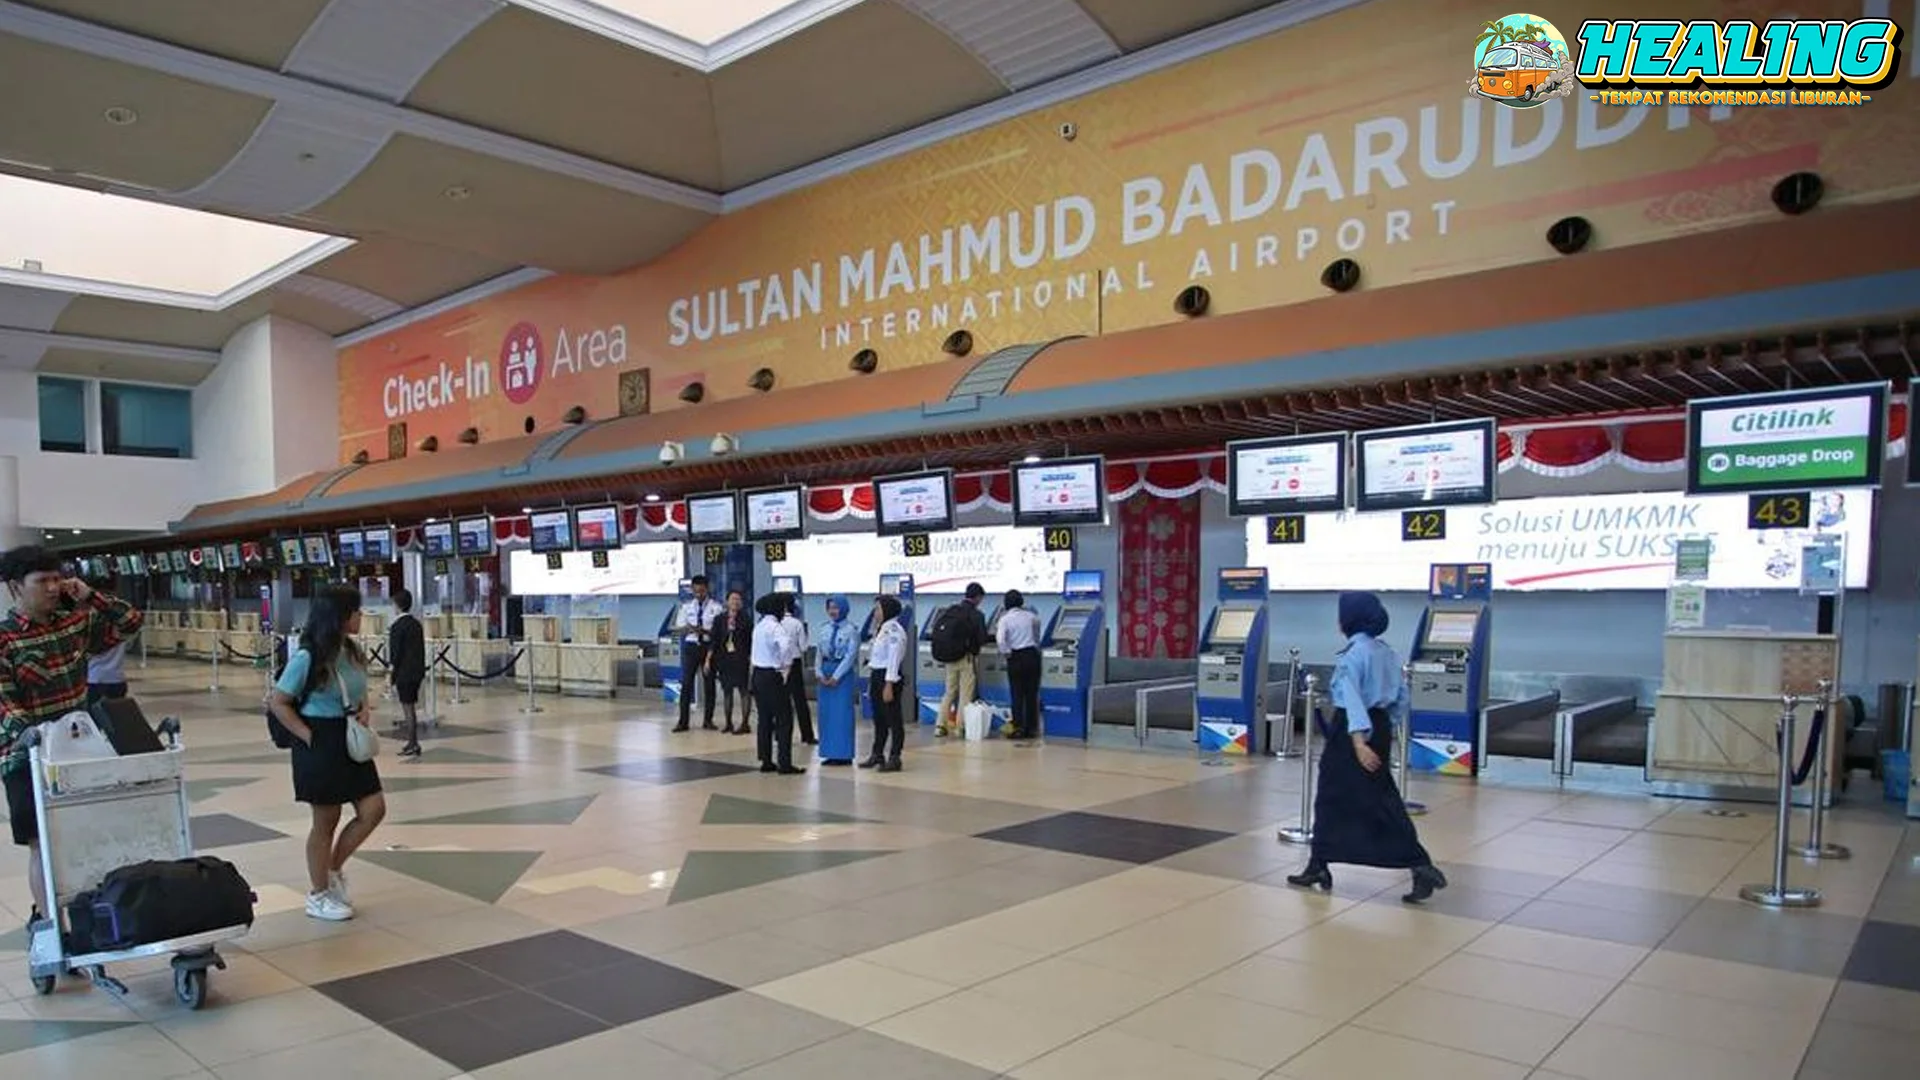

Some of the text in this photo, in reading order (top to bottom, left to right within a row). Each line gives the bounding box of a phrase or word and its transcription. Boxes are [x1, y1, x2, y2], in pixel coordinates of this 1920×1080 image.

[668, 262, 822, 347] SULTAN
[839, 195, 1097, 307] MAHMUD
[821, 201, 1457, 350] INTERNATIONAL AIRPORT
[383, 324, 627, 419] Check-In Area
[1731, 407, 1835, 433] Citilink
[1735, 449, 1855, 469] Baggage Drop
[1477, 503, 1702, 534] Solusi UMKMK
[1755, 497, 1801, 525] 43
[1273, 519, 1298, 540] 41
[1407, 514, 1440, 537] 42
[906, 537, 926, 554] 39
[1048, 529, 1070, 549] 40
[1477, 536, 1588, 565] menuju
[706, 546, 720, 562] 37
[767, 544, 782, 559] 38
